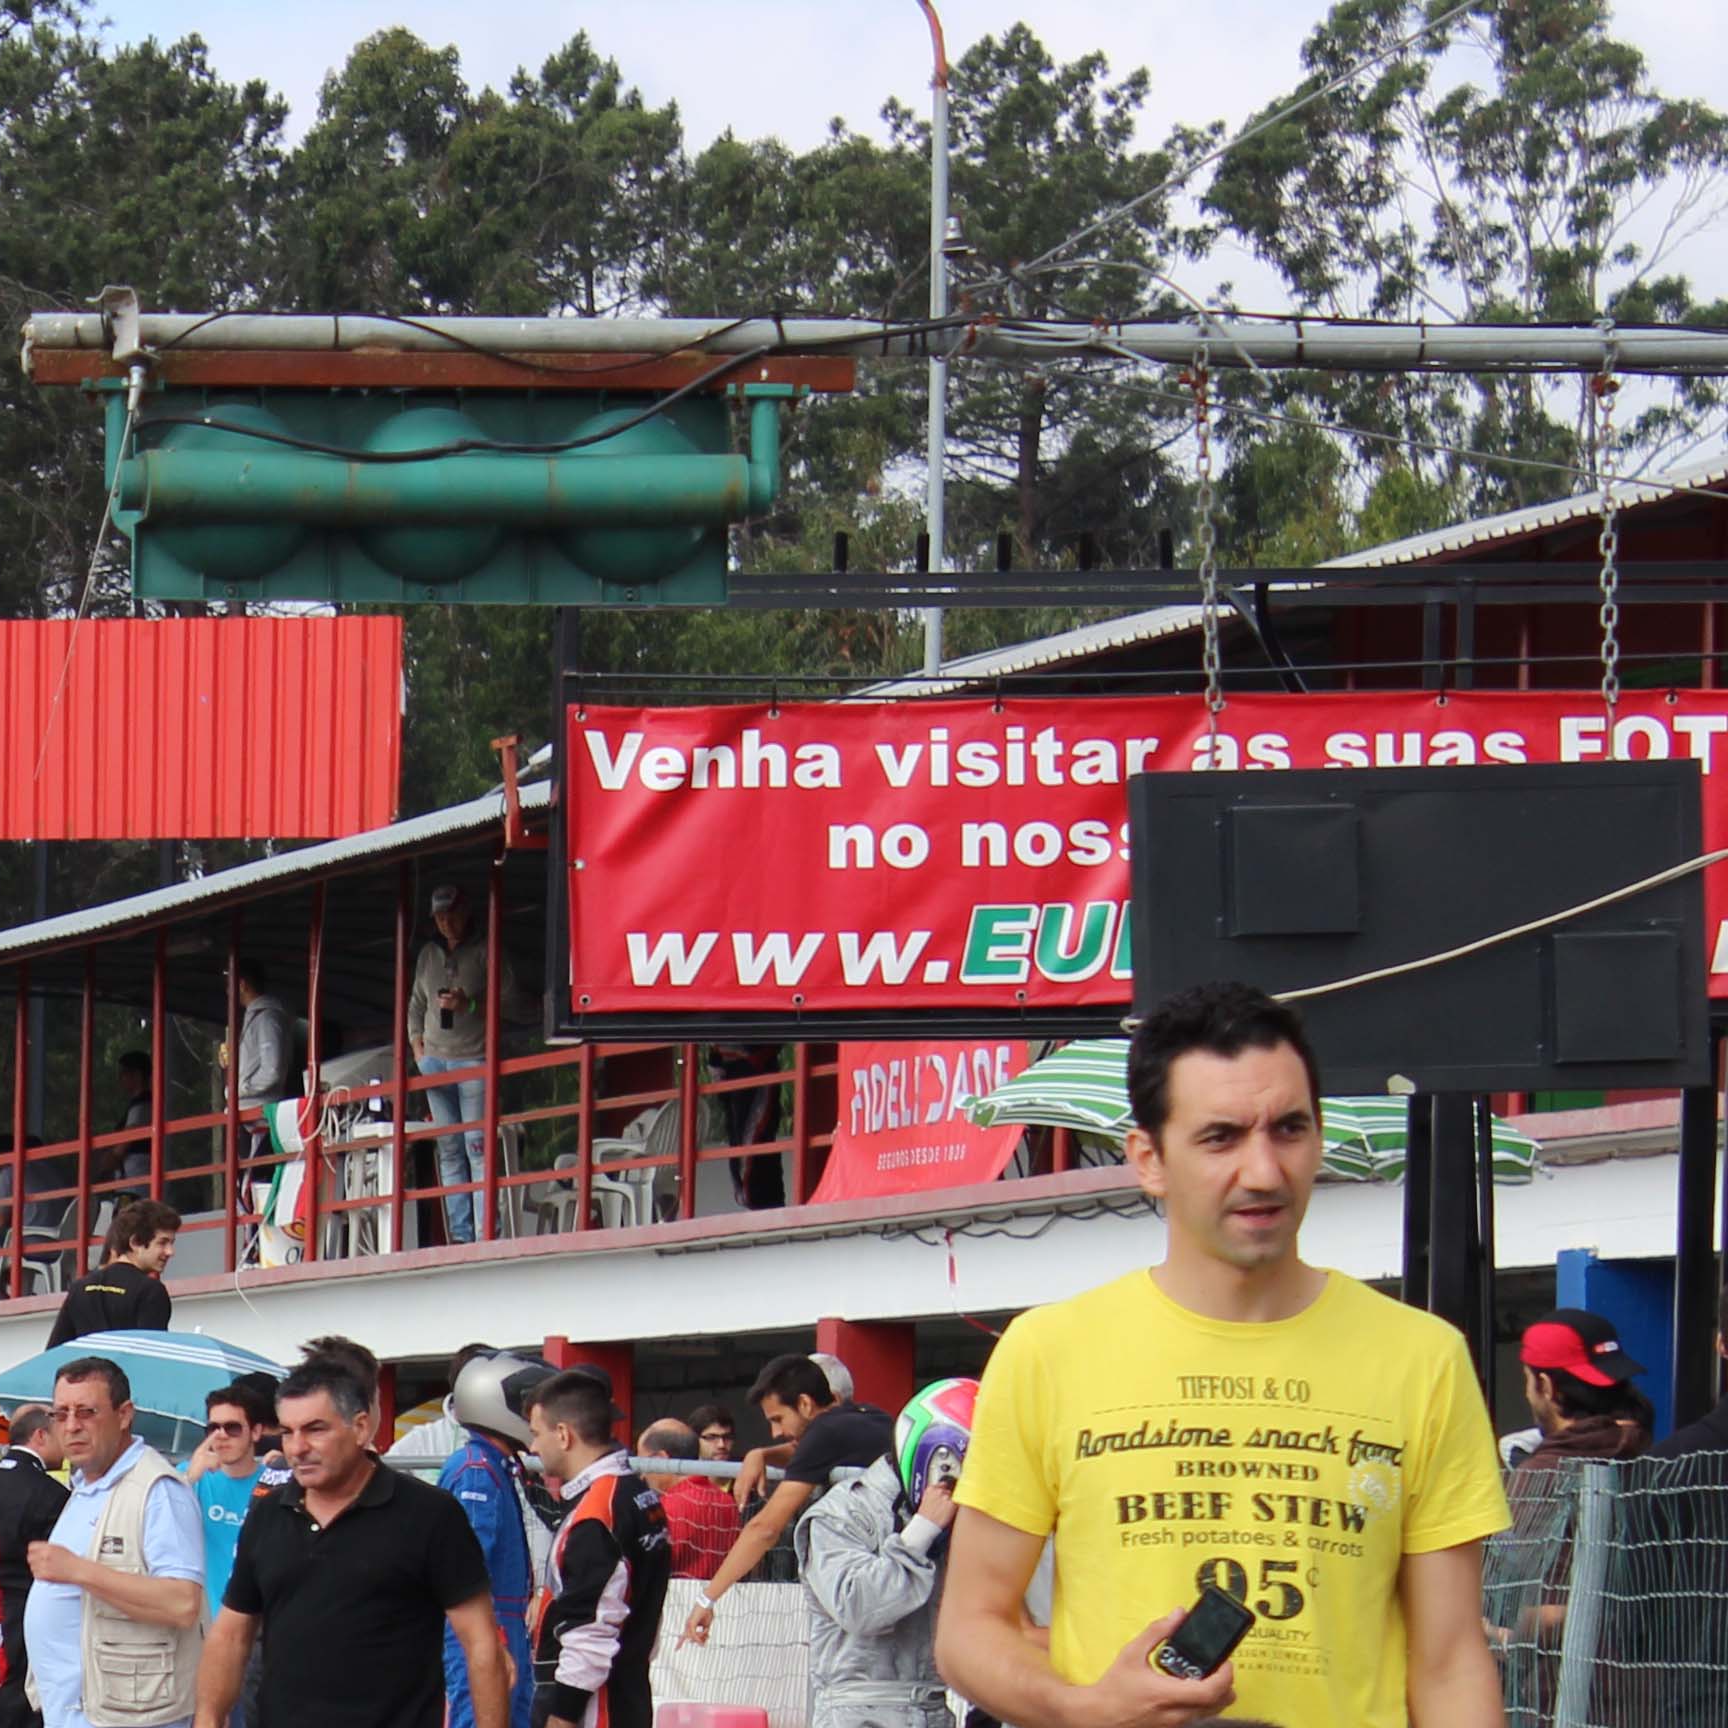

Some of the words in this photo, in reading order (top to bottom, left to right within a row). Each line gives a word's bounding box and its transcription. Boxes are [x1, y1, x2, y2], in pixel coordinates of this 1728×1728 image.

[584, 729, 841, 791] Venha
[875, 726, 1160, 788] visitar
[1191, 731, 1292, 771] as
[1323, 729, 1527, 768] suas
[828, 823, 930, 868] no
[1176, 1376, 1255, 1400] TIFFOSI
[1262, 1378, 1281, 1401] &
[1284, 1379, 1311, 1403] CO
[1075, 1420, 1234, 1461] Roadstone
[1244, 1425, 1340, 1455] snack
[1175, 1459, 1320, 1483] BROWNED
[1114, 1490, 1233, 1525] BEEF
[1251, 1491, 1369, 1534] STEW
[1120, 1527, 1175, 1548] Fresh
[1181, 1530, 1276, 1553] potatoes
[1281, 1533, 1298, 1549] &
